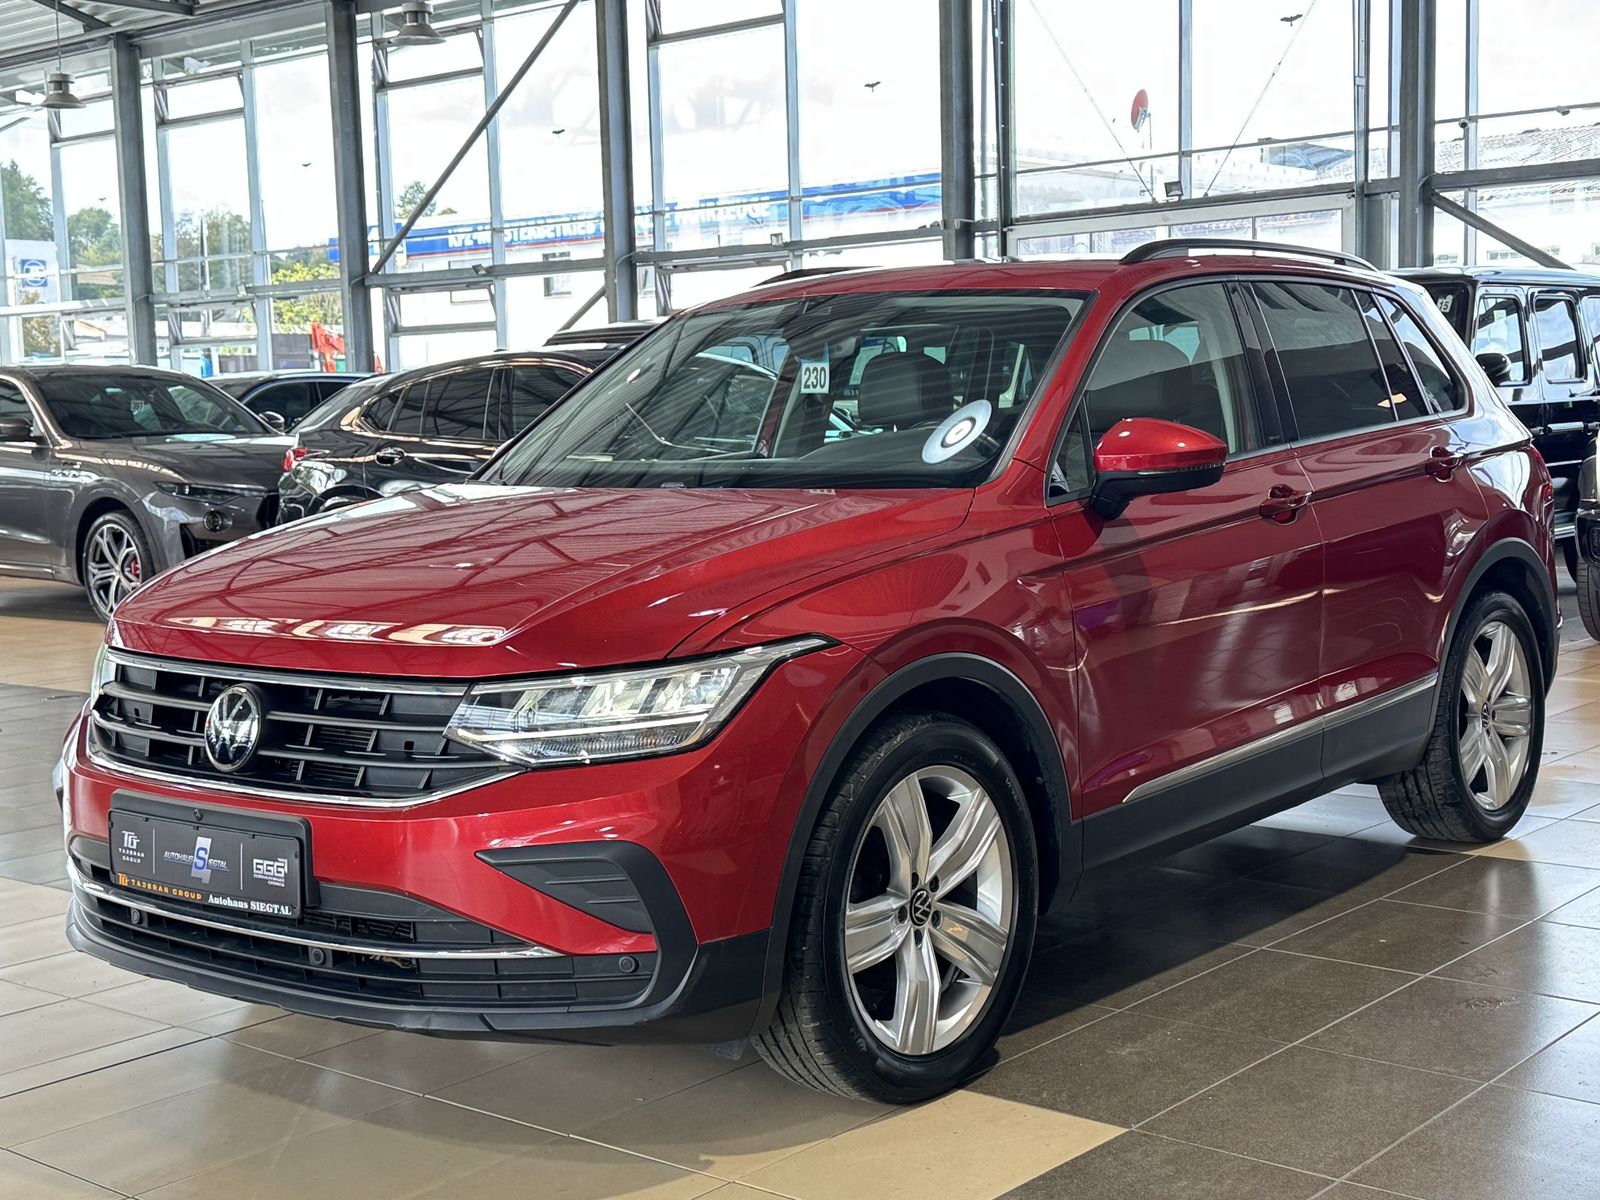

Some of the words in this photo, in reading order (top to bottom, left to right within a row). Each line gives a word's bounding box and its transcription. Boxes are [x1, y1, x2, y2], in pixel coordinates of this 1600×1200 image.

[803, 366, 827, 389] 230
[163, 850, 194, 863] AUTOHAUS
[253, 858, 285, 878] GGG
[172, 888, 202, 900] GROUP
[208, 894, 249, 909] Autohaus
[250, 901, 292, 916] SIEGTAL
